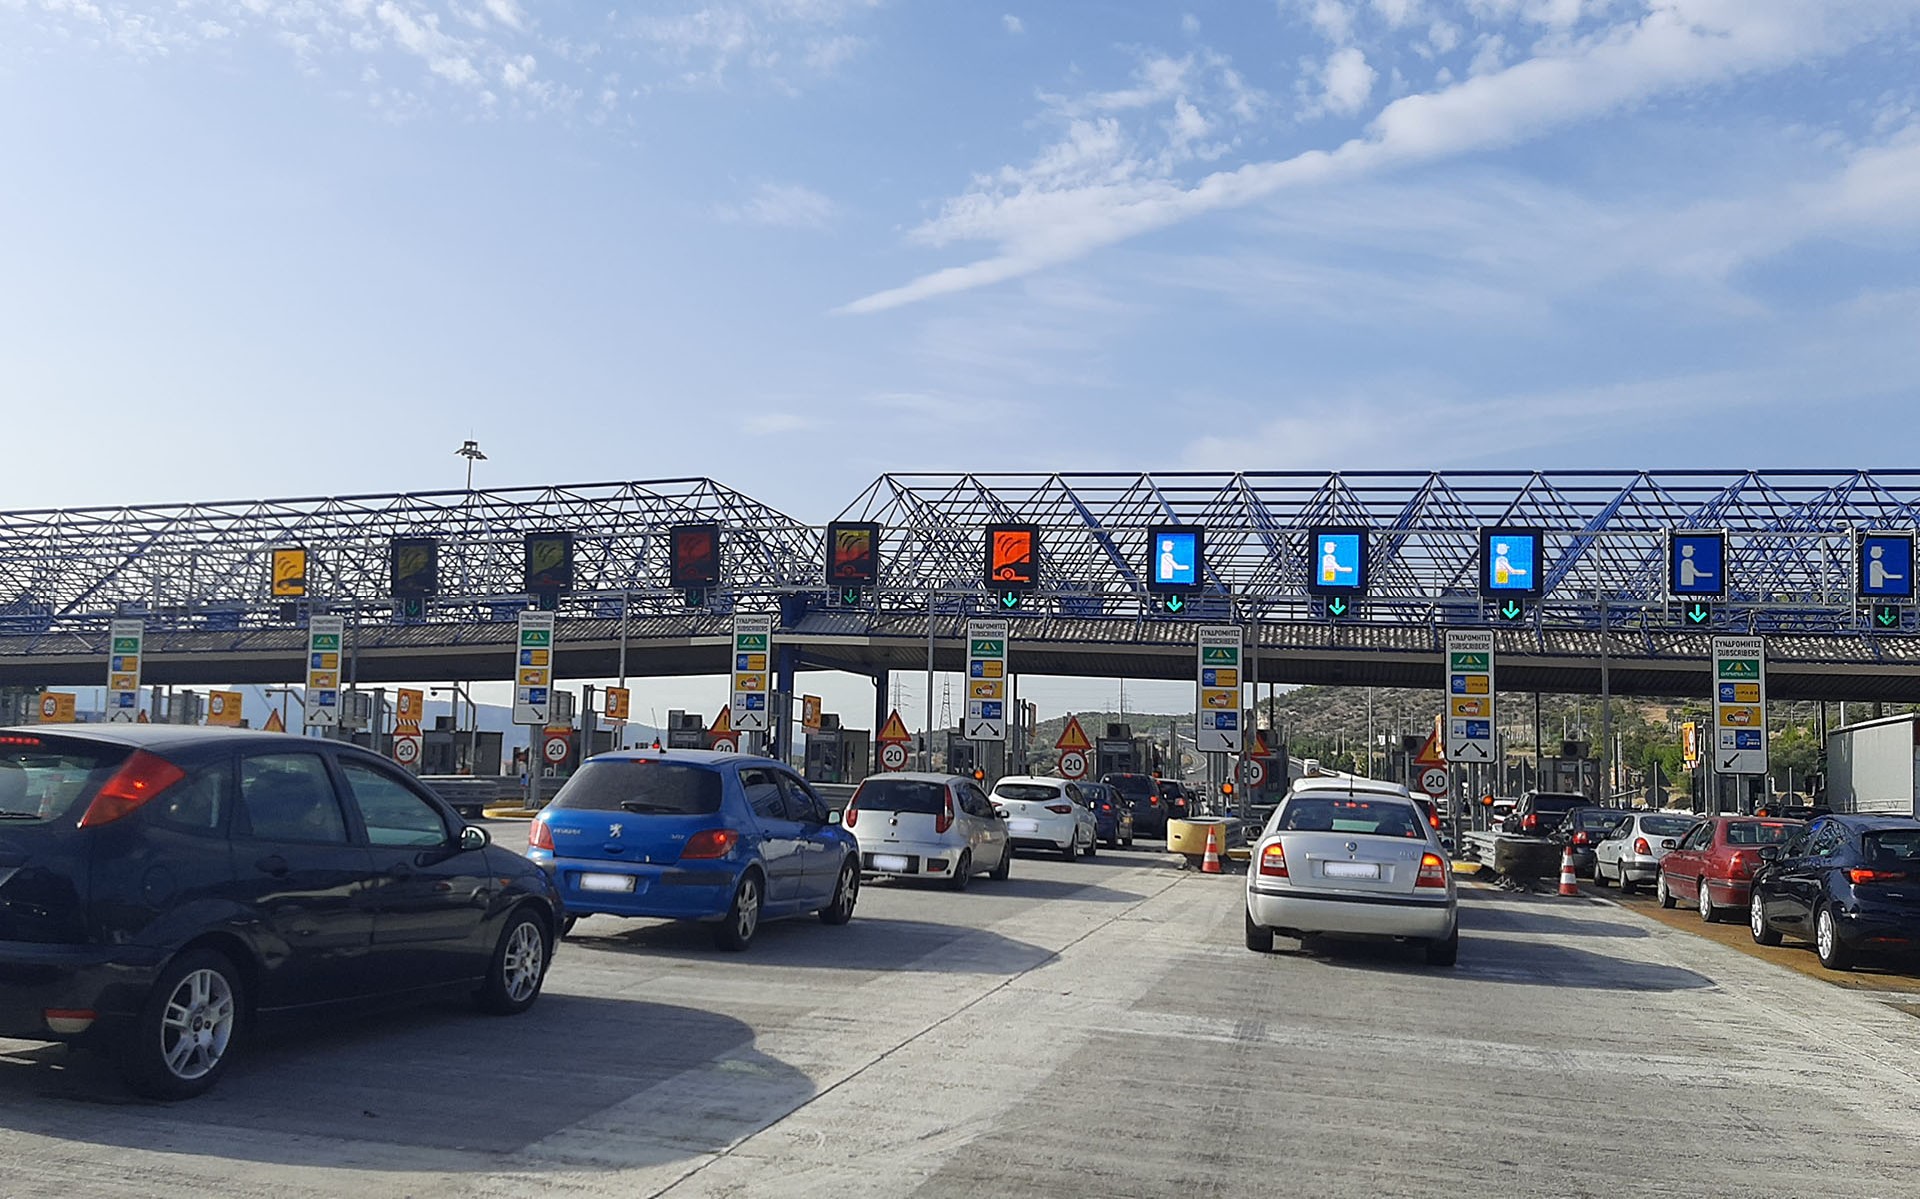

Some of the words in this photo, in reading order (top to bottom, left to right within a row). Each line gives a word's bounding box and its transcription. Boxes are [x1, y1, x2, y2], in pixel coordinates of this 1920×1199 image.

[1715, 640, 1762, 648] ΣΥΝΔΡΟΜΗΤΕΣ
[1717, 649, 1760, 657] SUBSCRIBERS
[399, 745, 414, 756] 20
[549, 744, 564, 755] 20
[886, 750, 902, 761] 20
[1065, 759, 1082, 770] 20
[1425, 776, 1445, 788] 20
